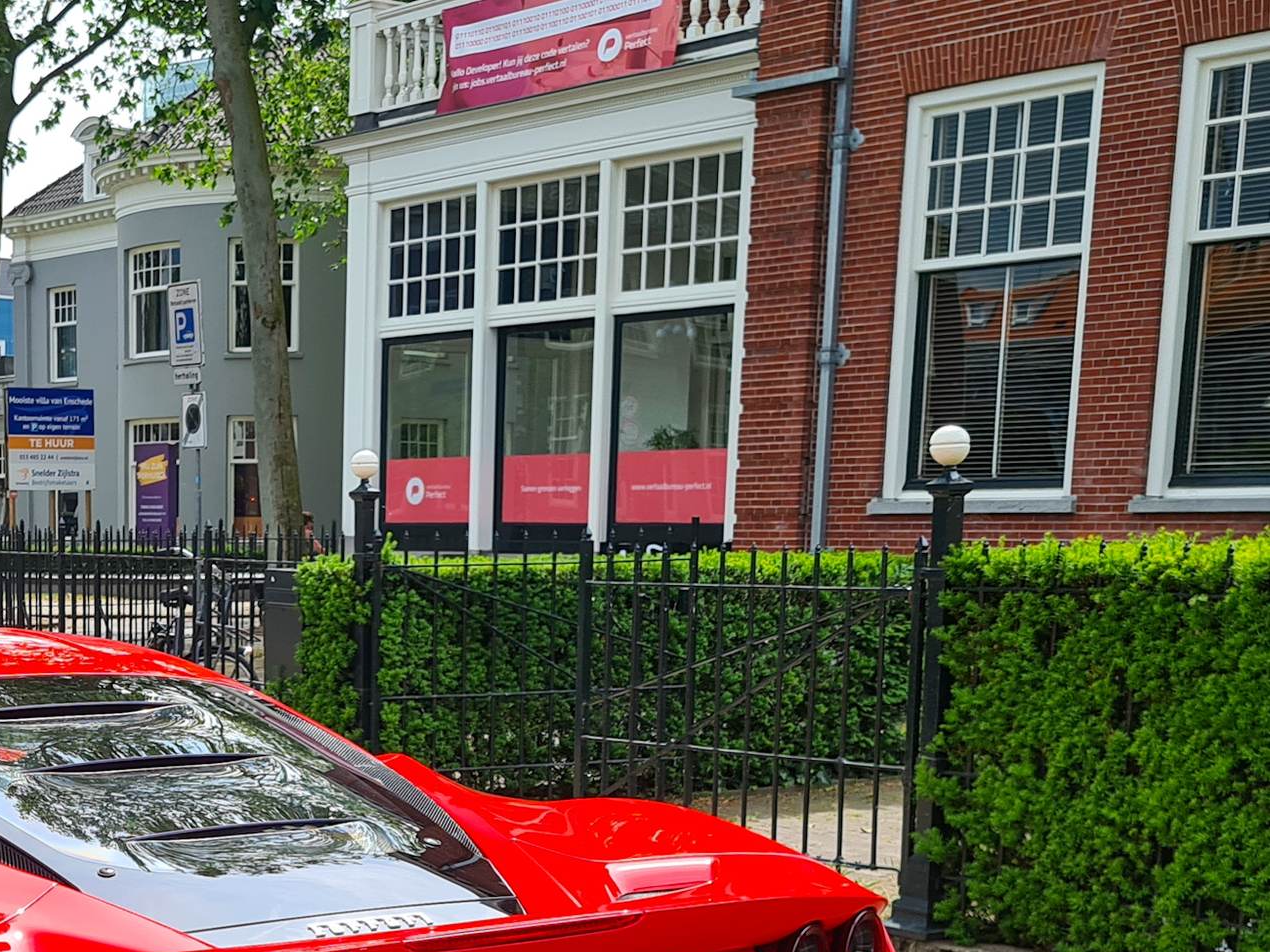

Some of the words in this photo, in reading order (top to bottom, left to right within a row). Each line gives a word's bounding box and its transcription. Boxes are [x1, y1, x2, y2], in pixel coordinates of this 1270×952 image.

[623, 36, 652, 51] Perfect
[466, 60, 502, 76] Developer!
[503, 58, 516, 68] Kun
[516, 55, 524, 68] jij
[524, 53, 540, 64] deze
[541, 48, 558, 60] code
[558, 38, 591, 55] vertalen?
[470, 58, 568, 90] jobs.vertaalbureau-perfect.nl
[176, 287, 190, 298] ZONE
[176, 312, 187, 341] P
[174, 371, 199, 381] herhaling
[9, 396, 34, 405] Mooiste
[36, 396, 50, 405] villa
[64, 397, 93, 406] Enschede
[14, 414, 52, 422] Kantoorruimte
[38, 424, 46, 432] op
[47, 423, 62, 432] eigen
[29, 438, 42, 448] TE
[44, 438, 74, 449] HUUR
[31, 469, 56, 478] Snelder
[57, 469, 80, 479] Zijlstra
[31, 479, 78, 488] Bedrijfsmakelaars
[631, 481, 713, 492] www.vertaalbureau-perfect.nl
[425, 490, 447, 499] Perfect
